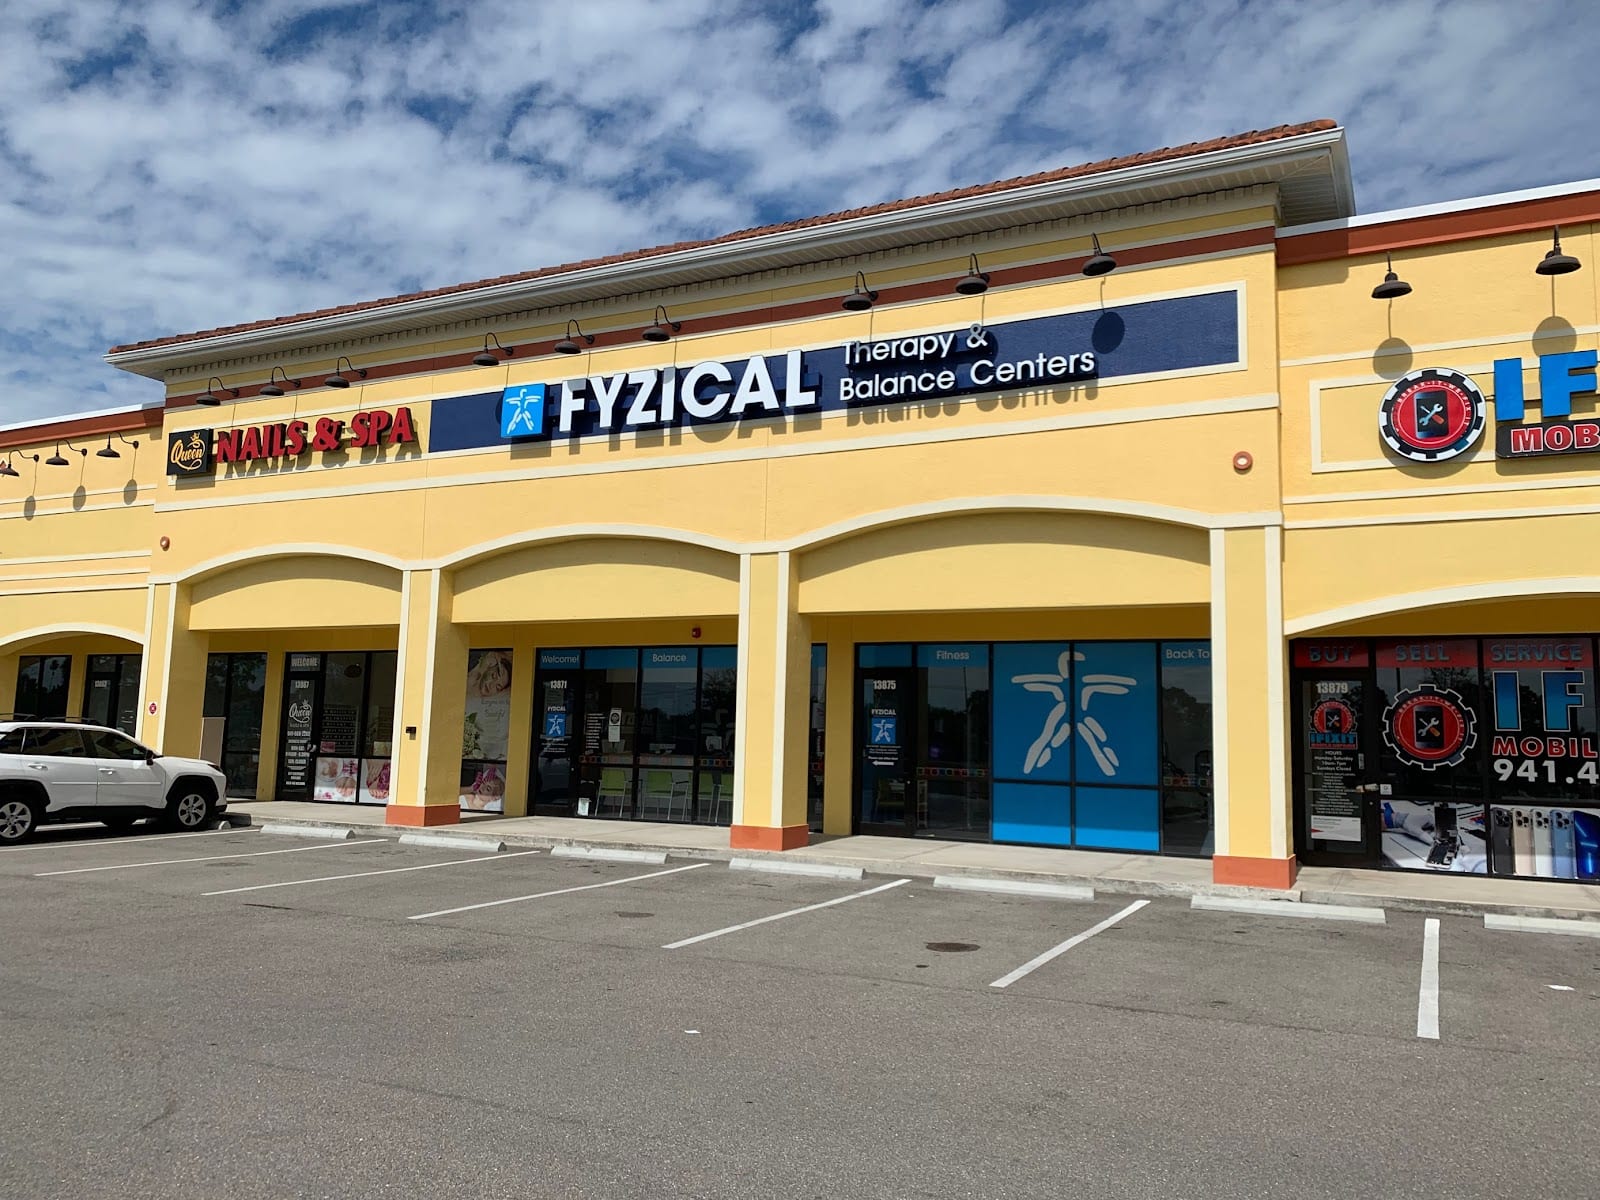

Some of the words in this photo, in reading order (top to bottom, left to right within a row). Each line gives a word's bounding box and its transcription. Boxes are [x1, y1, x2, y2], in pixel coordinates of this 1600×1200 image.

[841, 331, 954, 365] Therapy
[966, 323, 988, 348] &
[839, 368, 955, 401] Balance
[970, 351, 1096, 385] Centers
[559, 350, 816, 432] FYZICAL
[215, 420, 308, 463] NAILS
[312, 417, 344, 450] &
[351, 406, 416, 448] SPA
[1510, 424, 1600, 454] MOB
[170, 438, 206, 471] Queen
[542, 655, 579, 664] Welcome!
[652, 653, 687, 663] Balance
[936, 650, 969, 661] Fitness
[1166, 649, 1195, 659] Back
[1197, 649, 1210, 659] To
[1308, 646, 1353, 662] BUY
[1395, 645, 1450, 661] SELL
[1491, 644, 1583, 661] SERVICE
[291, 657, 318, 667] WELCOME
[873, 680, 897, 690] 13875
[1316, 682, 1348, 694] 13879
[289, 702, 312, 723] Queen
[871, 708, 897, 716] FYZICAL
[1492, 736, 1598, 758] MOBIL
